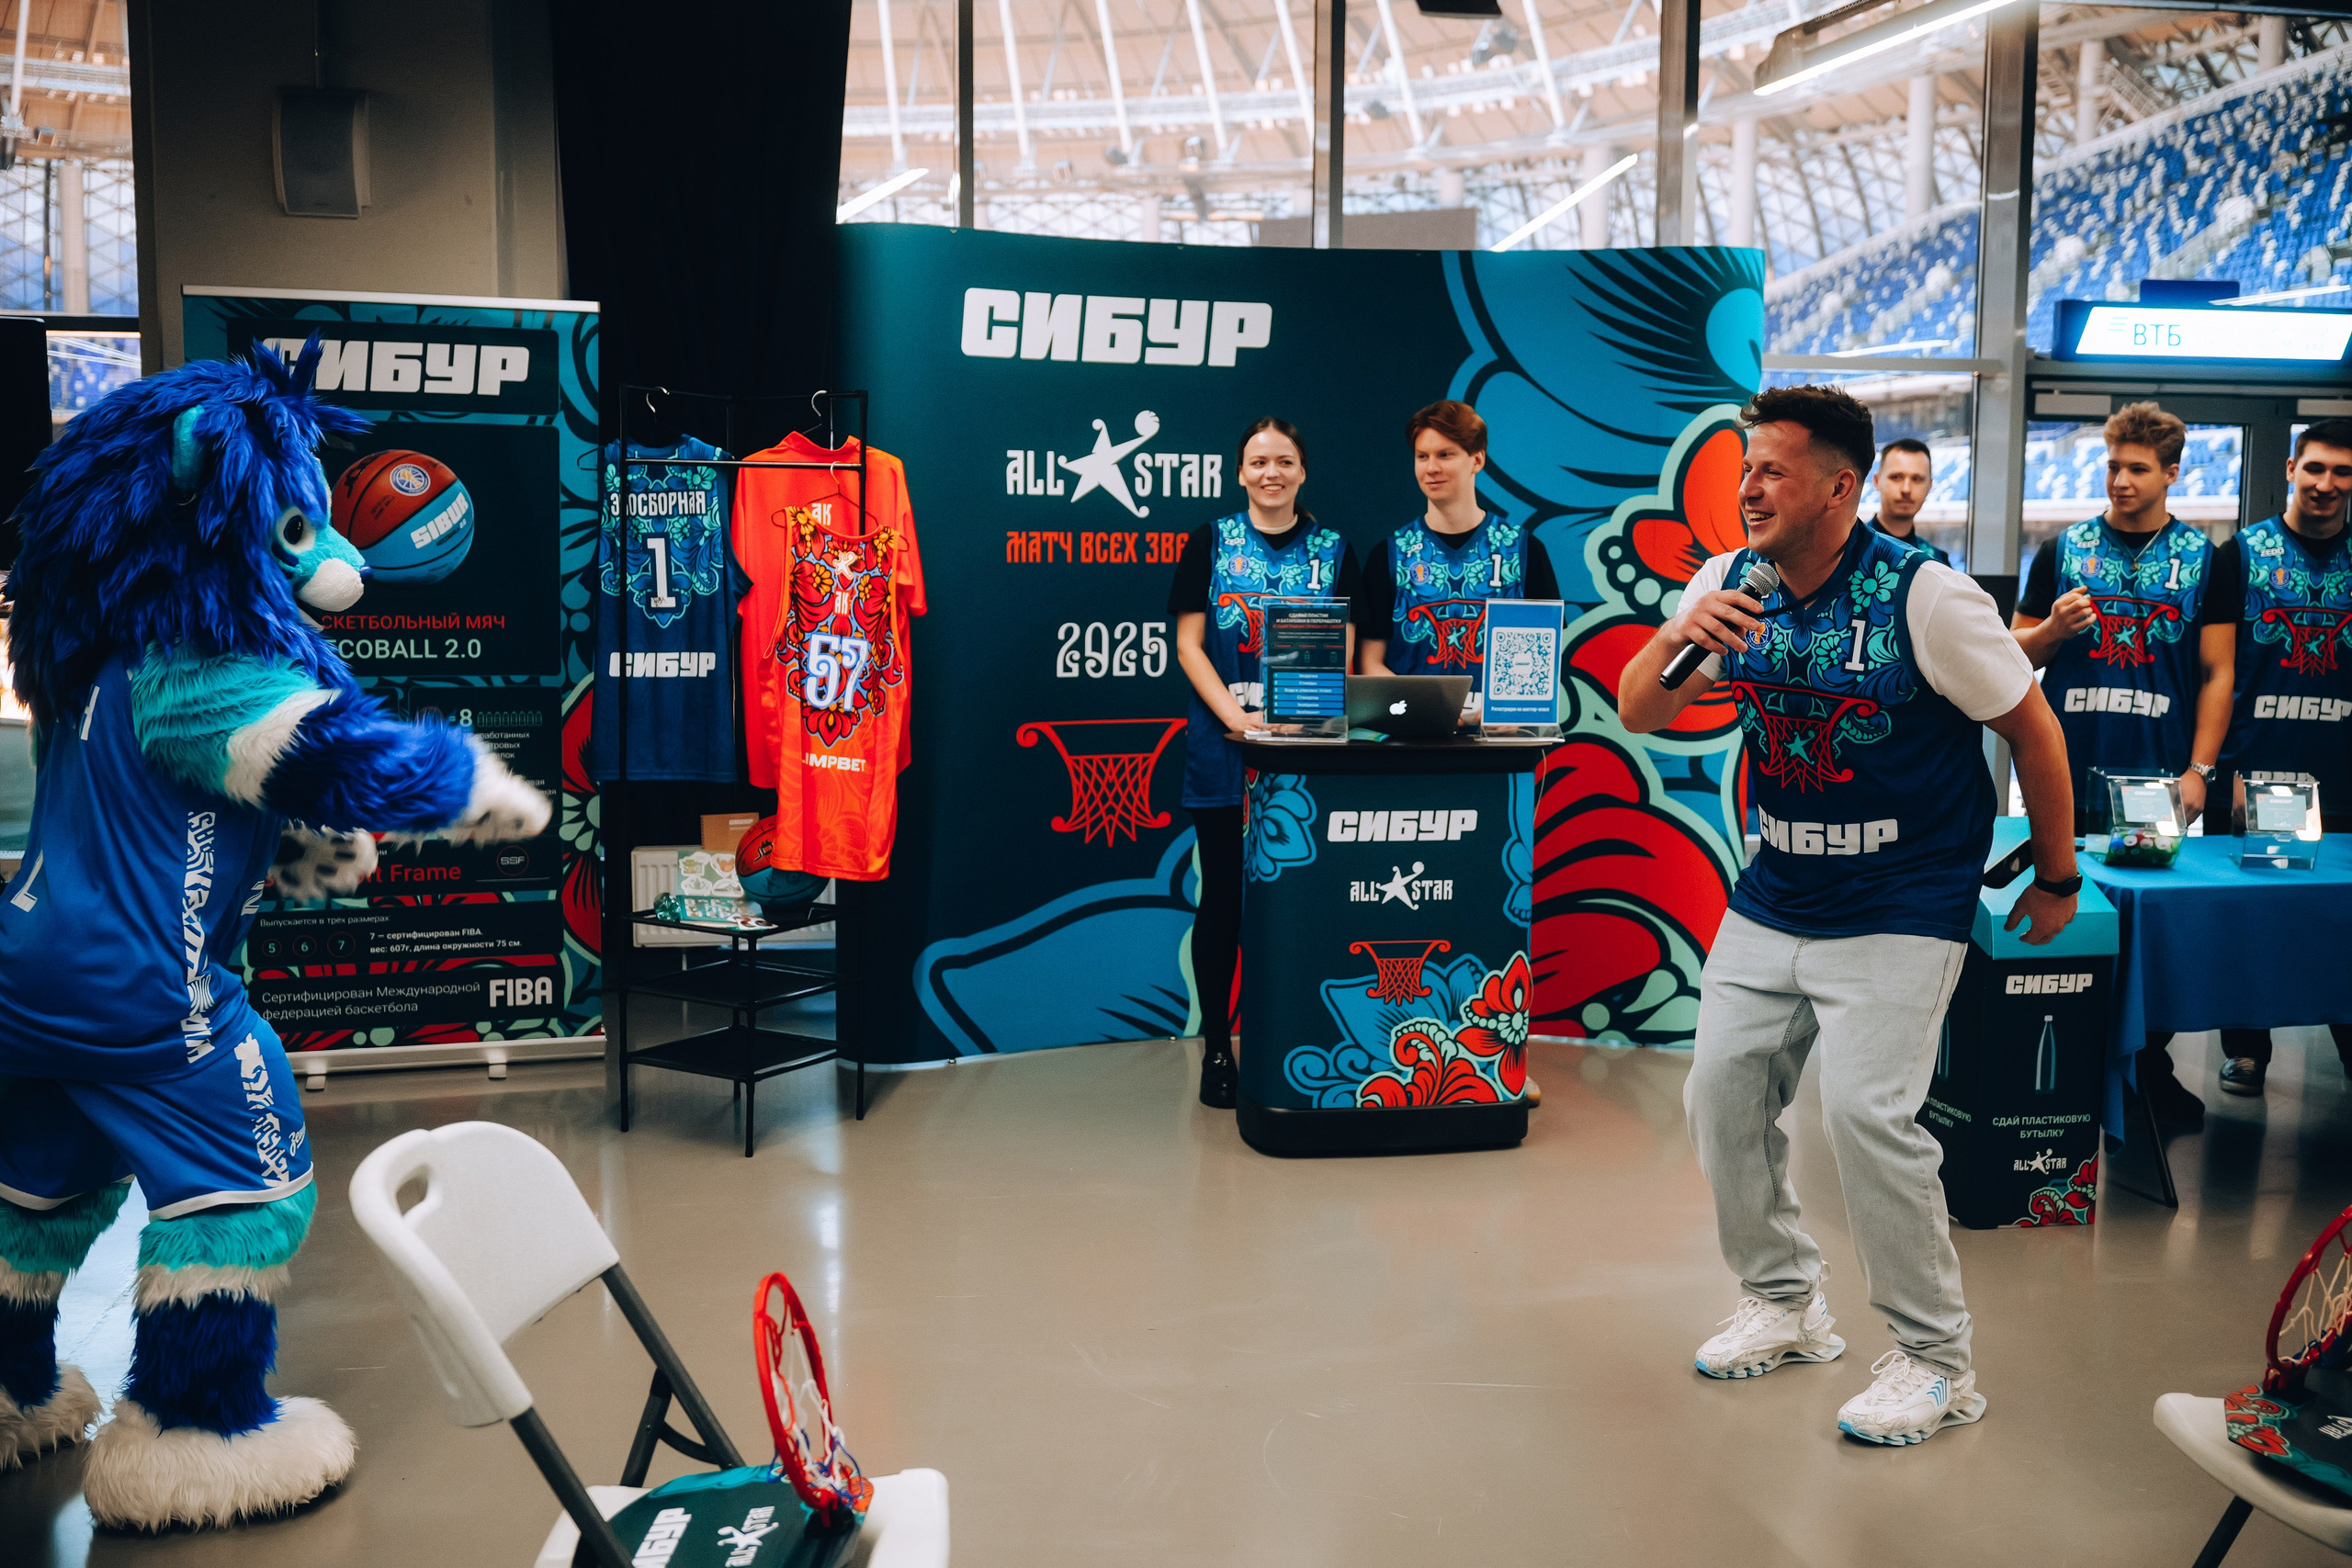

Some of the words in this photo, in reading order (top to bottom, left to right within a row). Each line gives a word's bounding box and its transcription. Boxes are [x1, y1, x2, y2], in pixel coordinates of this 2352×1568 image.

[961, 288, 1272, 367] СИБУР
[2133, 323, 2181, 346] ВТБ
[1006, 450, 1065, 496] ALL
[1134, 453, 1223, 498] STAR
[610, 491, 707, 516] ЭОСБОРНАЯ
[411, 491, 469, 549] SIBUR
[1006, 531, 1072, 563] МАТЧ
[1080, 532, 1138, 563] ВСЕХ
[1145, 533, 1190, 563] ЗВЕ
[647, 537, 676, 608] 1
[1307, 559, 1321, 590] 1
[1489, 554, 1502, 587] 1
[2165, 558, 2180, 591] 1
[322, 613, 459, 629] СКЕТБОЛЬНЫЙ
[466, 615, 505, 629] МЯЧ
[445, 638, 481, 659] 2.0
[1057, 621, 1168, 679] 2025
[1845, 619, 1865, 671] 1
[609, 651, 716, 678] СИБУР
[806, 633, 868, 710] 57
[2064, 687, 2170, 718] СИБУР
[459, 708, 473, 728] 8
[806, 752, 866, 772] IMPBET
[1328, 809, 1478, 842] СИБУР
[1758, 804, 1898, 855] СИБУР
[390, 863, 461, 883] Frame
[1350, 881, 1379, 902] ALL
[1411, 879, 1453, 901] STAR
[260, 918, 317, 928] Выпускается
[387, 930, 459, 940] сертифицирован
[268, 942, 276, 953] 5
[301, 941, 309, 952] 6
[338, 939, 345, 951] 7
[370, 945, 388, 953] вес:
[413, 943, 440, 953] длина
[443, 941, 494, 951] окружности
[262, 987, 373, 1004] Сертифицирован
[377, 981, 481, 998] Международной
[489, 976, 553, 1009] FIBA
[2006, 974, 2093, 995] СИБУР
[263, 1005, 342, 1021] федерацией
[345, 1000, 418, 1016] баскетбола
[1993, 1115, 2019, 1127] СДАЙ
[2022, 1114, 2091, 1125] ПЛАСТИКОВУЮ
[2020, 1129, 2064, 1139] БУТЫЛКУ
[2014, 1159, 2029, 1171] ALL
[2045, 1157, 2067, 1170] STAR
[632, 1507, 692, 1568] ИБУР
